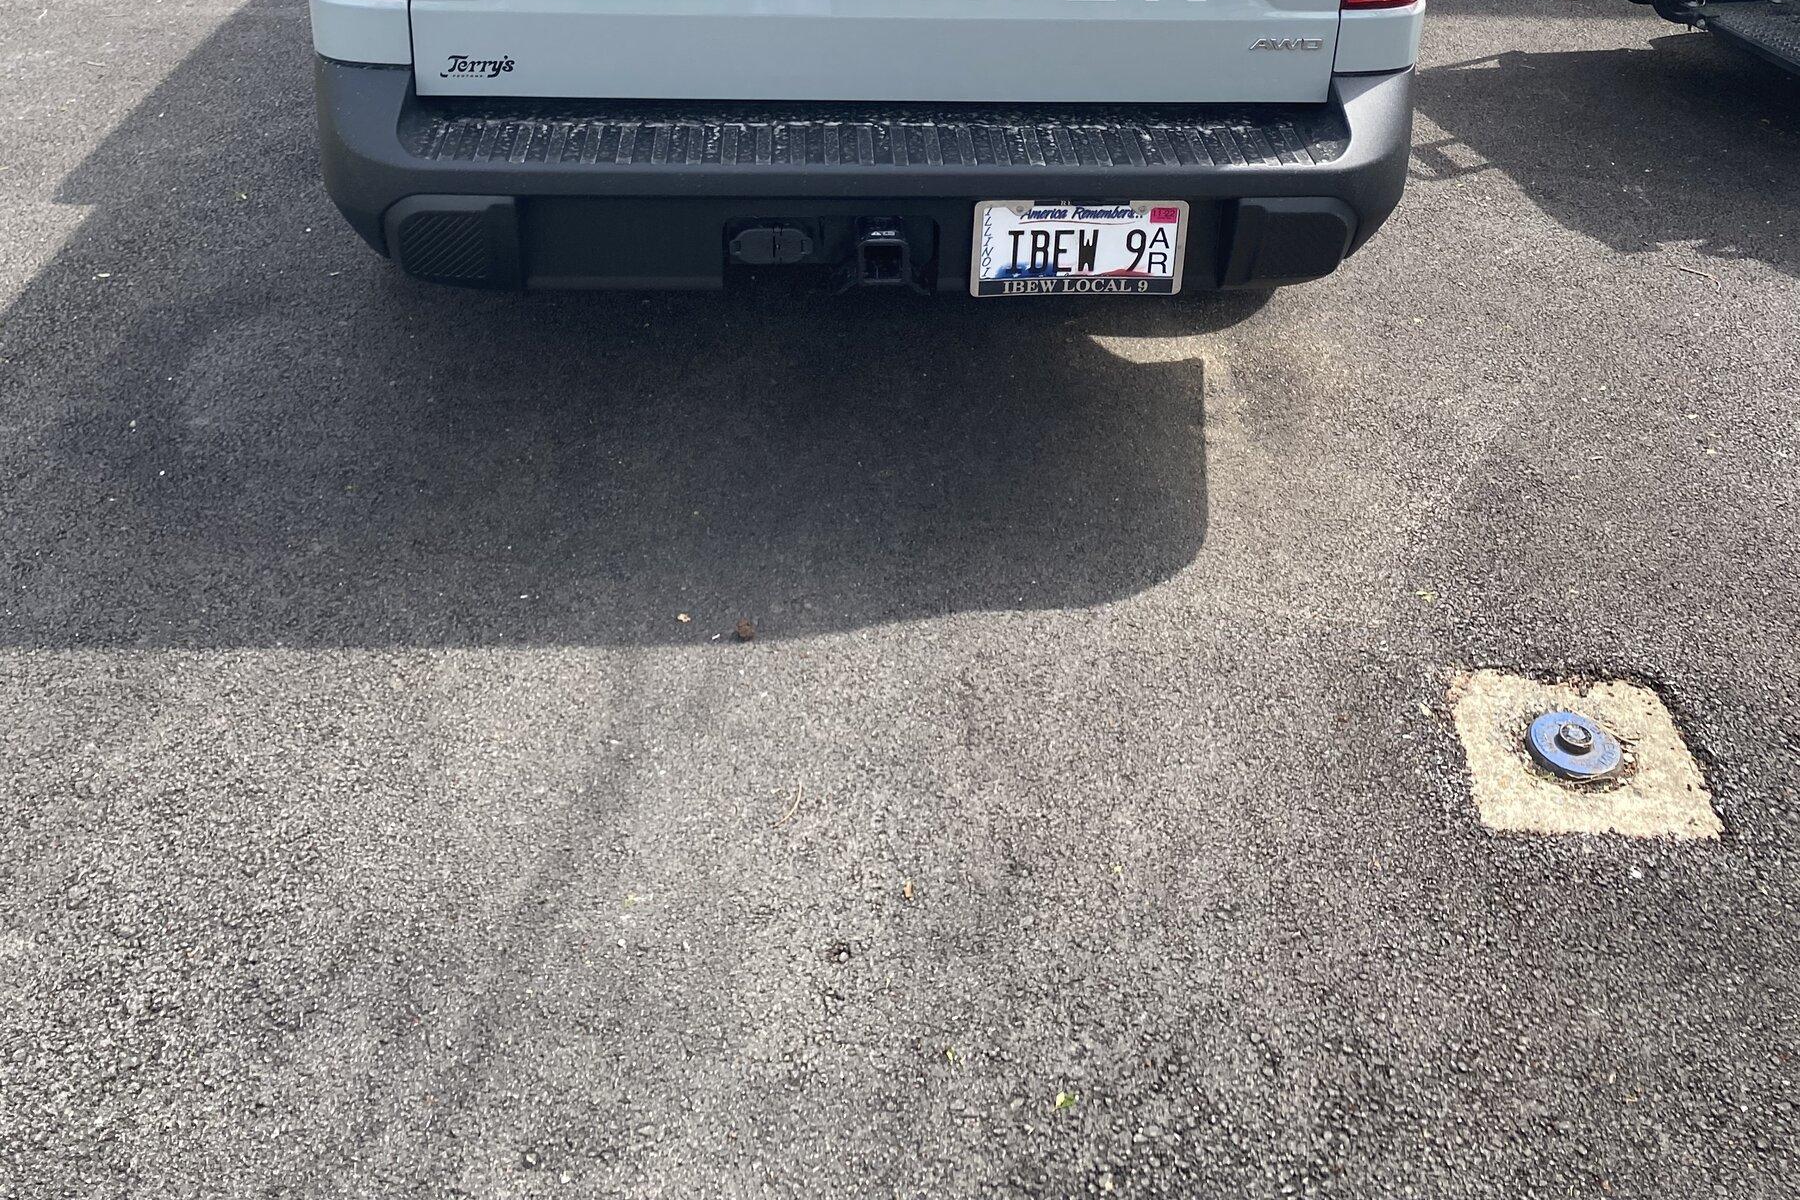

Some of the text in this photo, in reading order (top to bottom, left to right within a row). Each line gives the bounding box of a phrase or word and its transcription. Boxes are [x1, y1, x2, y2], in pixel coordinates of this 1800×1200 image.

[1249, 38, 1323, 51] AWD
[440, 55, 516, 78] Terry's
[1020, 208, 1068, 220] America
[1008, 228, 1148, 274] IBEW 9
[1003, 279, 1149, 294] IBEW LOCAL 9
